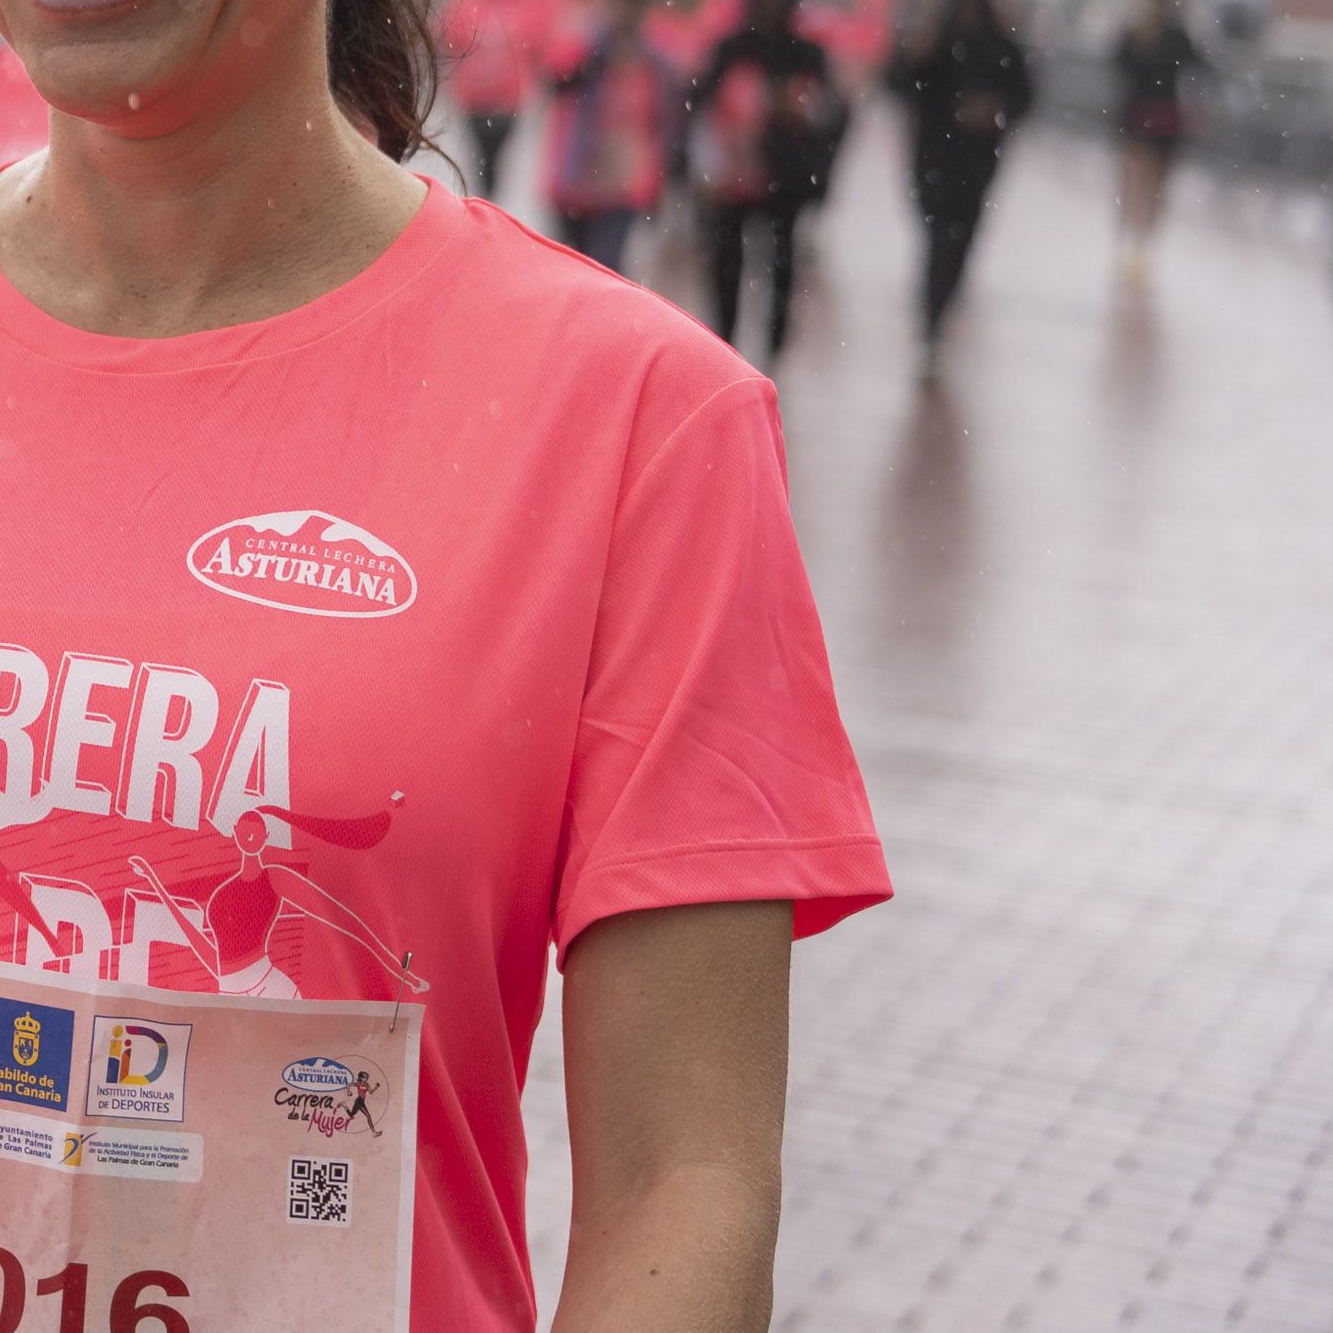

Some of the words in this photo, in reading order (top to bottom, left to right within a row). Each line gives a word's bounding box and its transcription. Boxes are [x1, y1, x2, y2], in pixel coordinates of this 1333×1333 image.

[245, 537, 316, 556] CENTRAL
[324, 546, 396, 574] LECHERA
[200, 536, 398, 606] ASTURIANA
[39, 1075, 54, 1088] de
[287, 1067, 348, 1086] ASTURIANA
[15, 1083, 62, 1104] Canaria
[274, 1087, 335, 1109] Carrera
[112, 1098, 170, 1114] DEPORTES
[287, 1108, 299, 1120] de
[300, 1107, 310, 1122] la
[307, 1106, 355, 1138] Mujer
[4, 1143, 23, 1154] Gran
[24, 1146, 52, 1160] Canaria
[8, 1135, 21, 1144] Las
[25, 1138, 53, 1151] Palmas
[97, 1155, 108, 1163] Las
[108, 1156, 130, 1165] Palmas
[155, 1160, 180, 1169] Canaria
